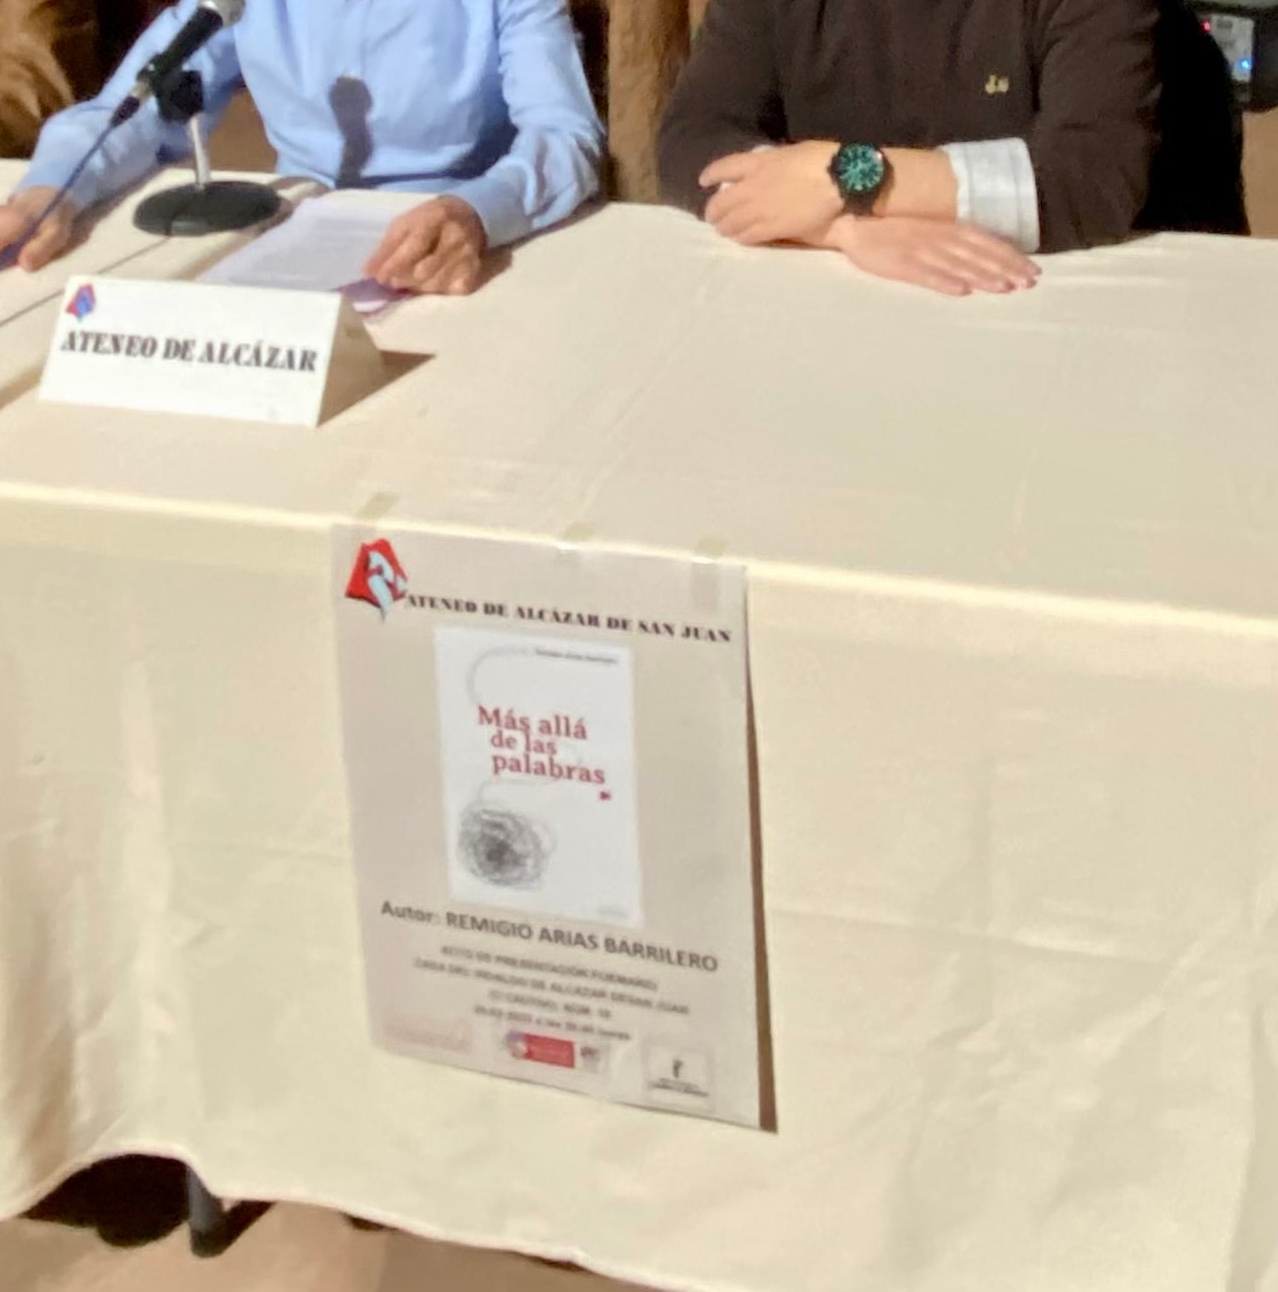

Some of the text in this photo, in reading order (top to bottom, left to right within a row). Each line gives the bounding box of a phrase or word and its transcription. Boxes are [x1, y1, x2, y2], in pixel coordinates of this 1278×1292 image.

[60, 330, 318, 373] ATENEO DE ALCÁZAR
[406, 594, 478, 614] ATENEO
[484, 603, 509, 618] DE
[606, 615, 634, 632] DE
[638, 620, 675, 637] SAN
[681, 625, 733, 643] JUAN
[478, 704, 588, 740] Más allá
[490, 728, 558, 755] de las
[492, 752, 606, 785] palabras
[445, 911, 534, 941] REMIGIO
[537, 927, 599, 951] ARIAS
[604, 937, 719, 973] BARRILERO
